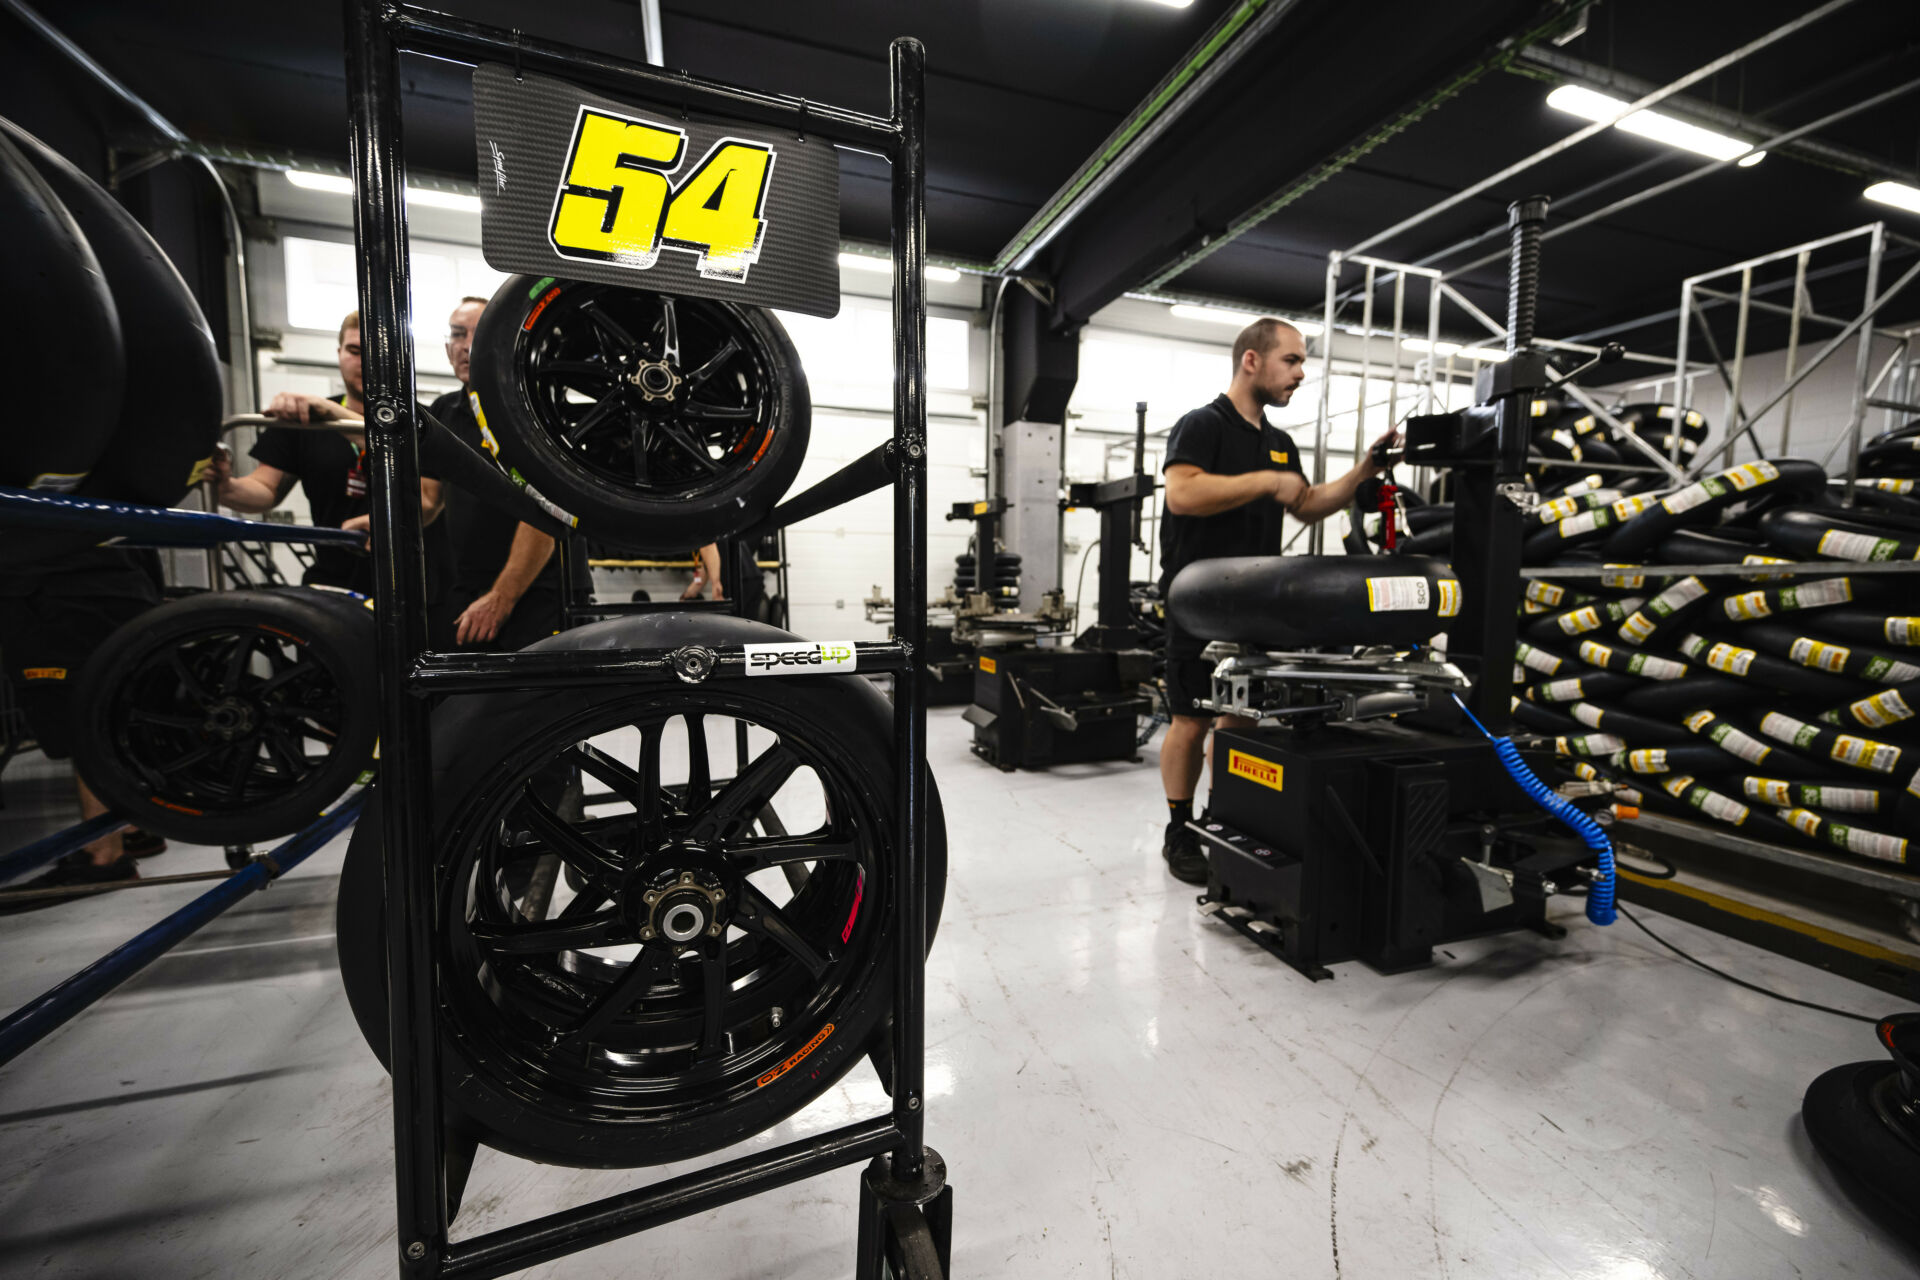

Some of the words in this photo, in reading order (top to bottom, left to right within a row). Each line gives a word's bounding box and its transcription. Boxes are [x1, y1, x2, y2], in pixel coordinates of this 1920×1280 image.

[548, 105, 777, 284] 54
[1233, 755, 1278, 784] PIRELLI
[789, 1033, 826, 1066] RACING
